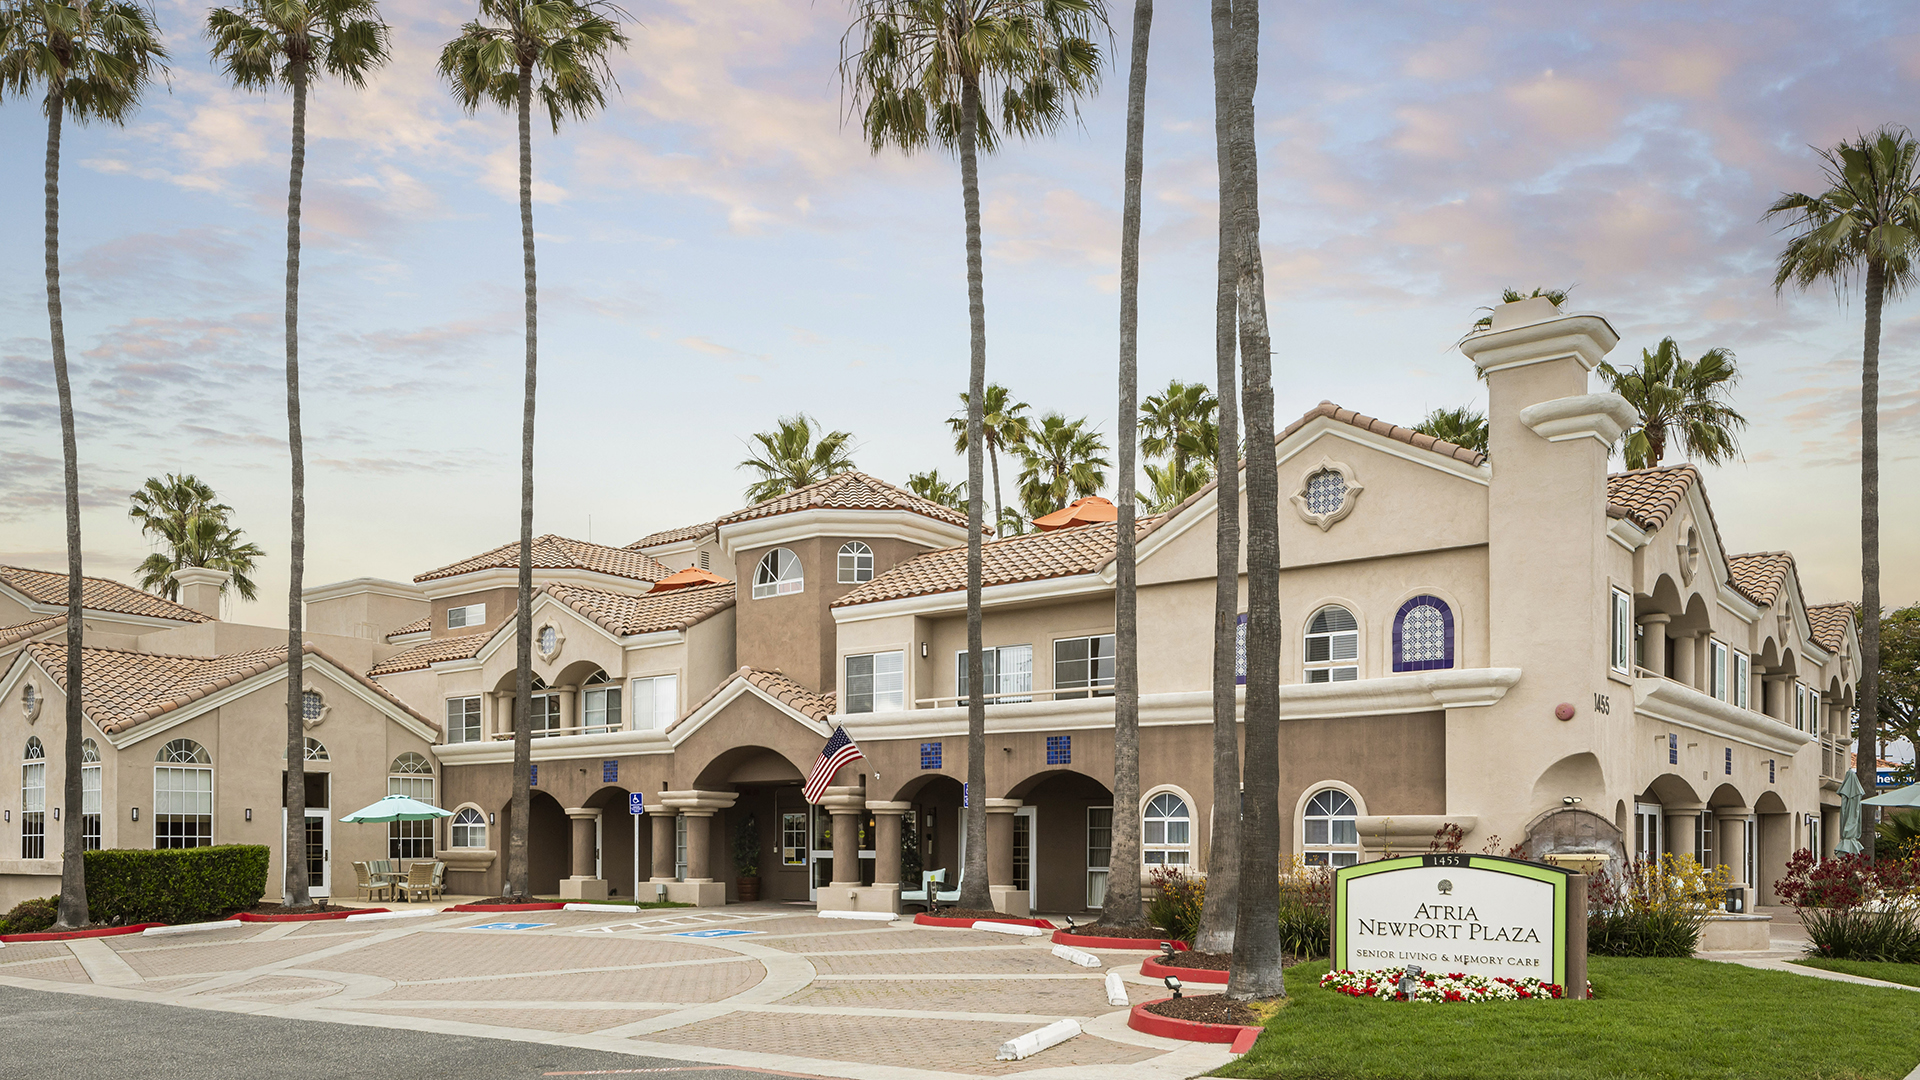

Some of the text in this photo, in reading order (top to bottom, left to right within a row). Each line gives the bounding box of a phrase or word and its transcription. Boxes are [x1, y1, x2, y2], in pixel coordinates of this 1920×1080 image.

[1594, 692, 1610, 715] 1455
[1433, 856, 1460, 866] 1455
[1413, 902, 1479, 921] ATRIA
[1358, 918, 1541, 943] NEWPORT PLAZA
[1356, 948, 1540, 967] SENIOR LIVING & MEMORY CARE
